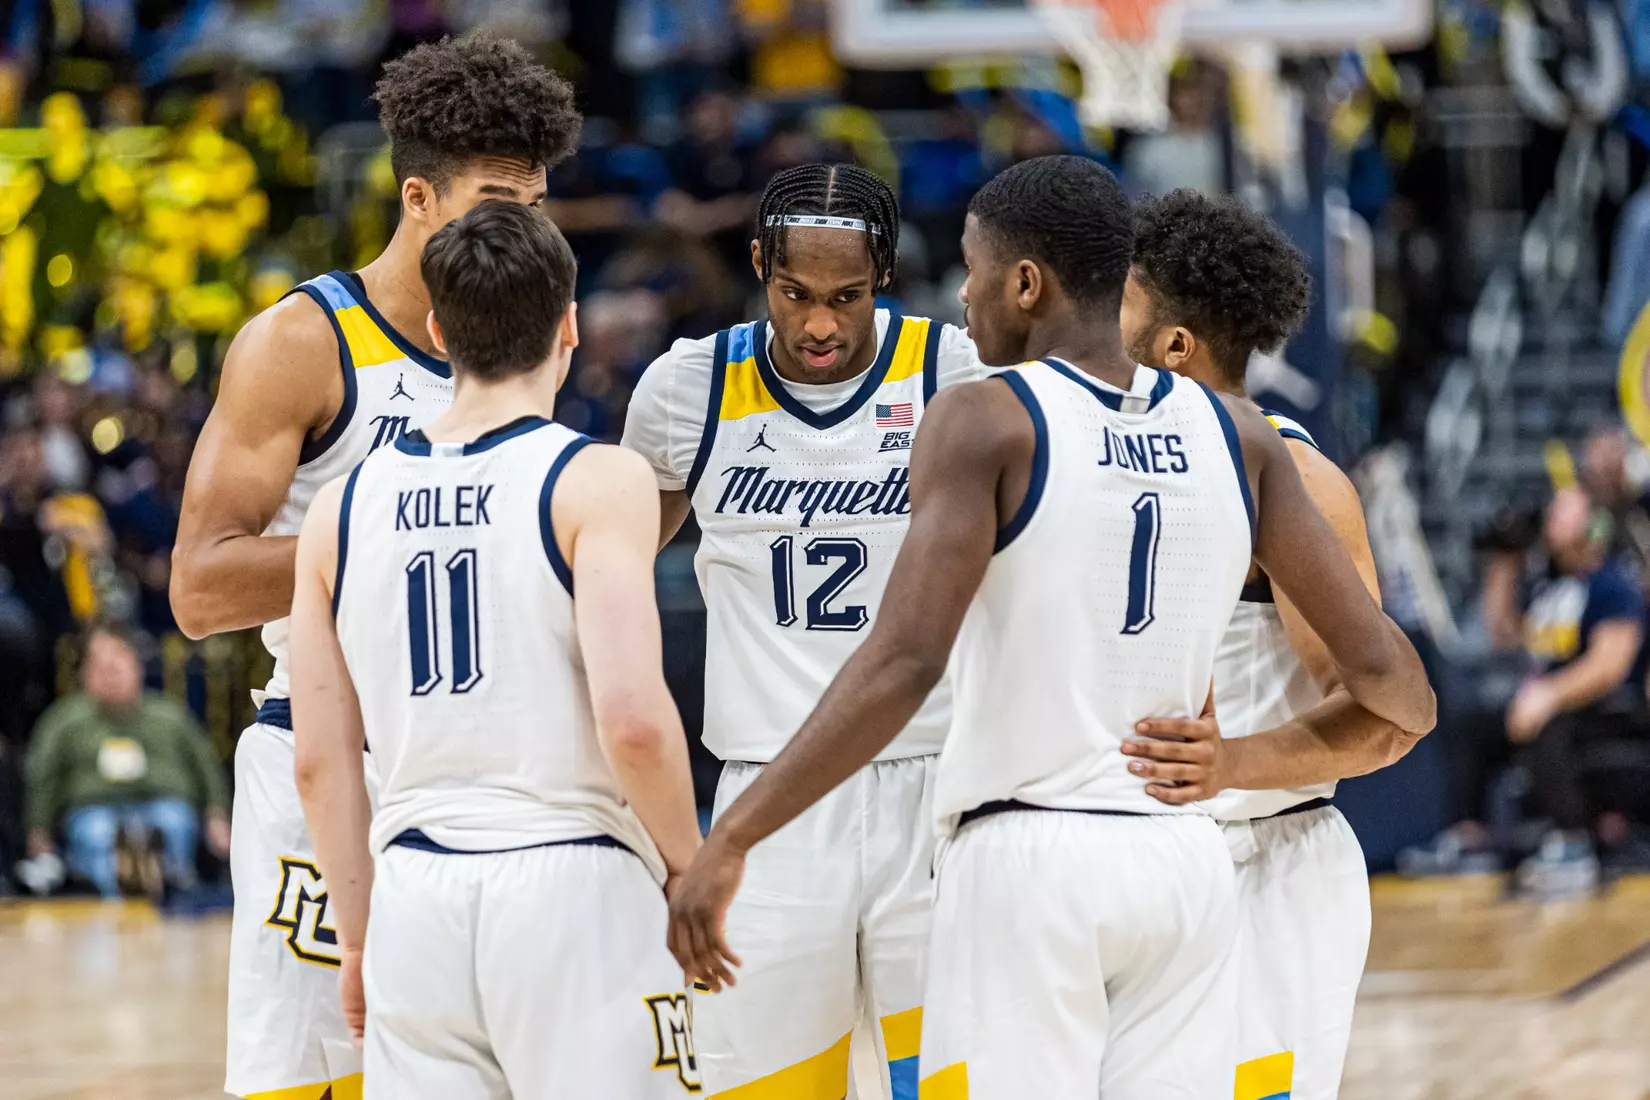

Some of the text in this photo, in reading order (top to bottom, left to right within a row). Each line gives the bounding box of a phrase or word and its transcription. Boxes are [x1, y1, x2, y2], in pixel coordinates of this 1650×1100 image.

[880, 439, 914, 449] EAS
[884, 431, 911, 440] BIG
[1098, 426, 1189, 473] JONES
[395, 484, 495, 531] KOLEK
[770, 535, 869, 632] 12
[1119, 491, 1161, 635] 1
[405, 548, 483, 697] 11
